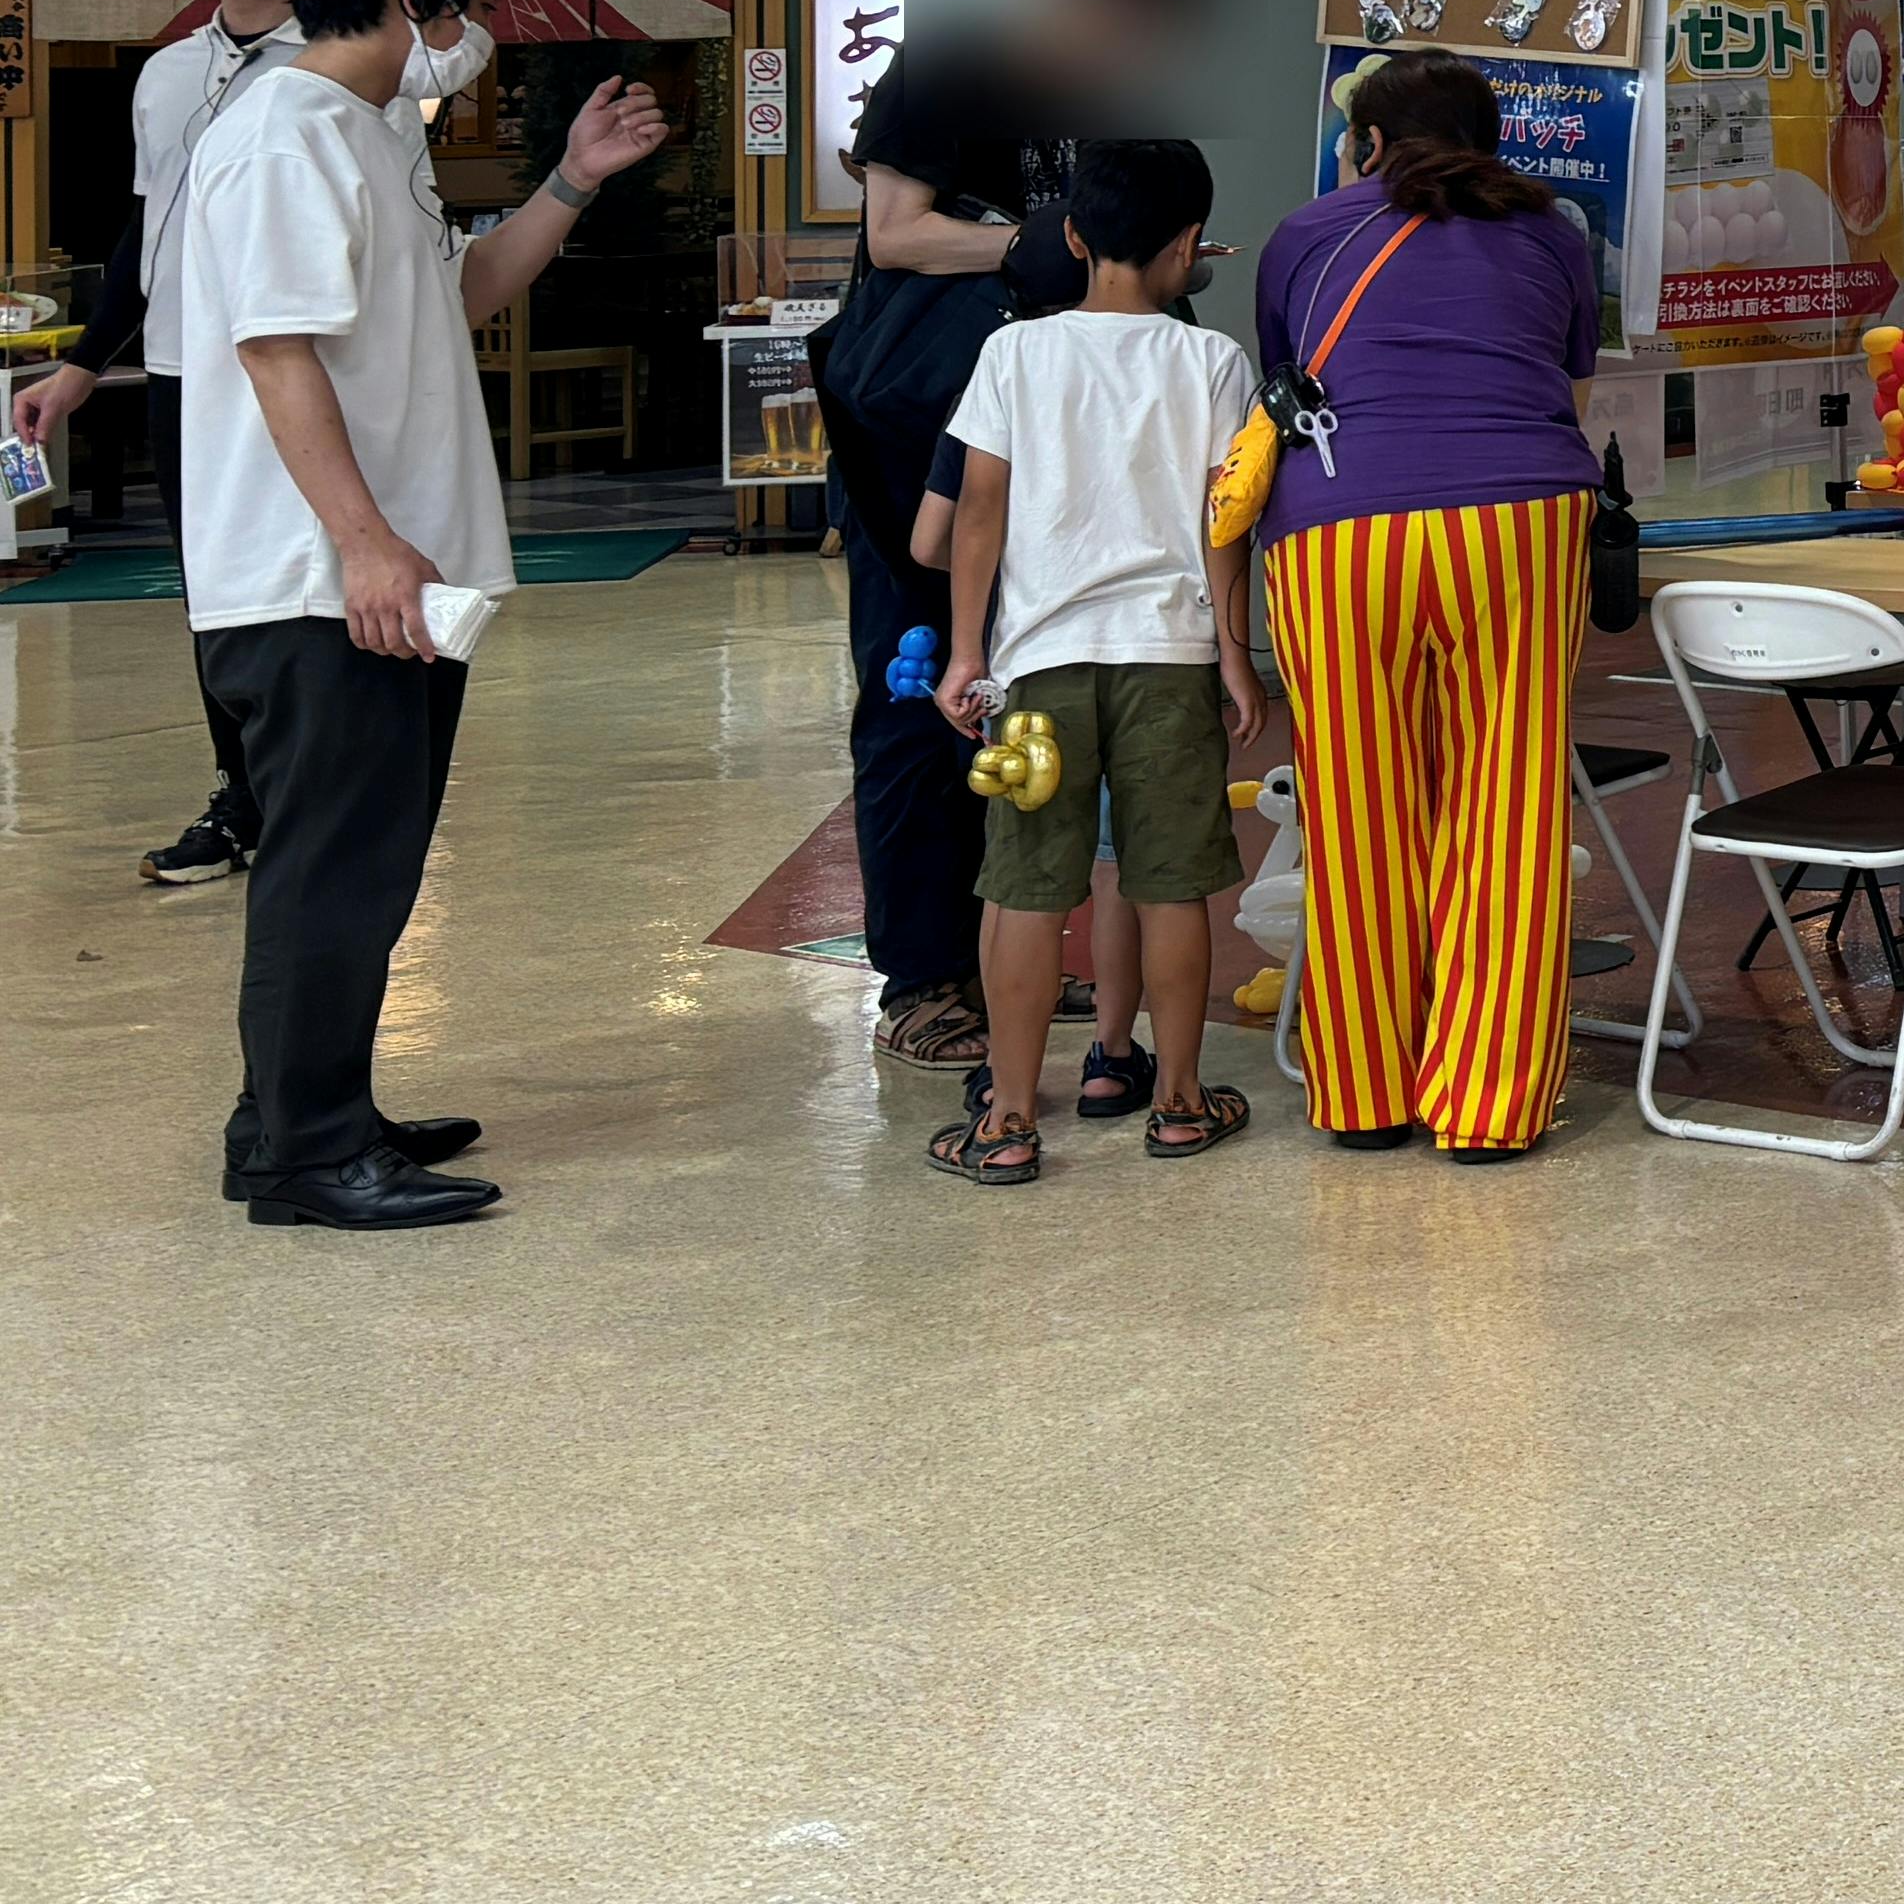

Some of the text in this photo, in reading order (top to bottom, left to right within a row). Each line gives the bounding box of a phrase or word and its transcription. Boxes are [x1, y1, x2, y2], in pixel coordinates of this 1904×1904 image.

[1501, 155, 1606, 180] ベント開催中！
